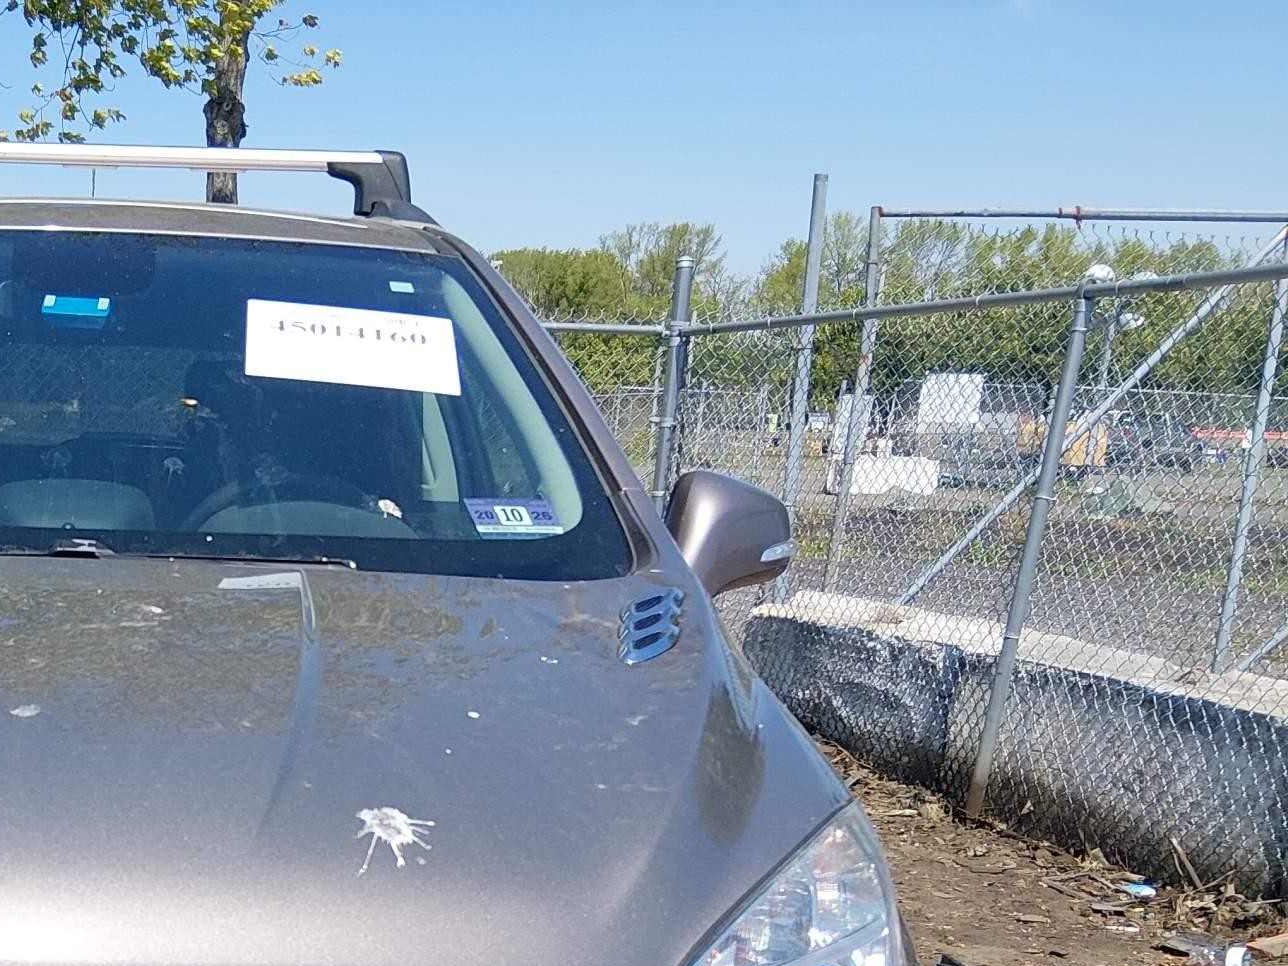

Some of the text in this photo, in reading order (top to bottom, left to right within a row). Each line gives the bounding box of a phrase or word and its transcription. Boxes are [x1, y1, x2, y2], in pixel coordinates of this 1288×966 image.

[270, 319, 427, 345] 45014160
[474, 508, 552, 522] 20 10 26
